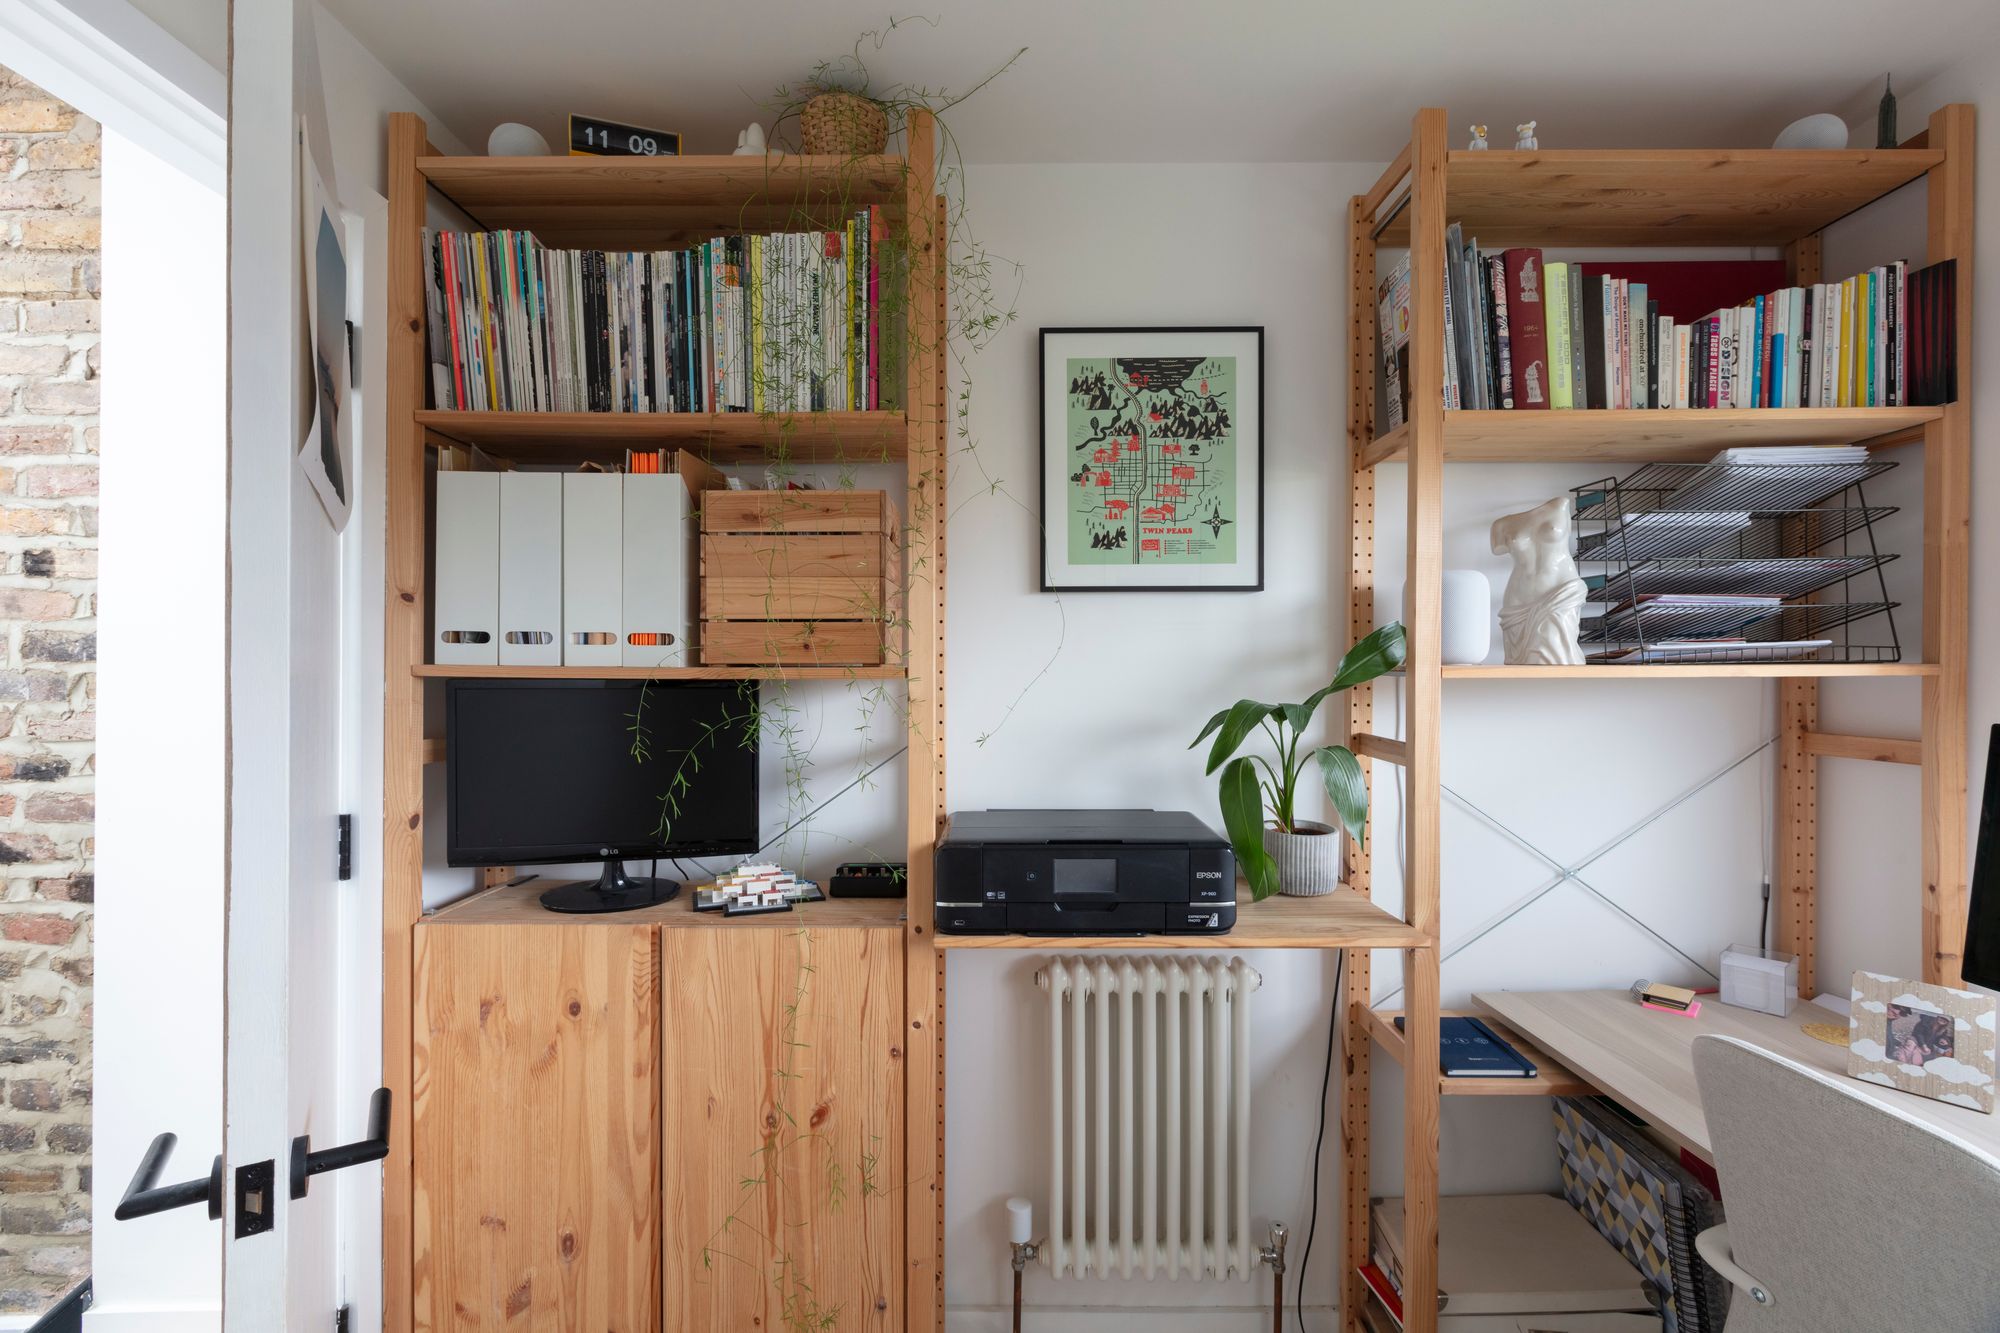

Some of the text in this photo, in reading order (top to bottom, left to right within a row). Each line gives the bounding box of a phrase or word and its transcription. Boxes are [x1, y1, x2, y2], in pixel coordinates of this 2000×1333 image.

[585, 127, 657, 156] 11 09
[1495, 260, 1505, 298] IMAGES
[812, 304, 820, 336] MAGAZINE
[1497, 314, 1509, 336] FIRE
[1709, 368, 1718, 392] PLACES
[1720, 350, 1731, 401] DESIGN
[1166, 527, 1193, 535] PEAKS
